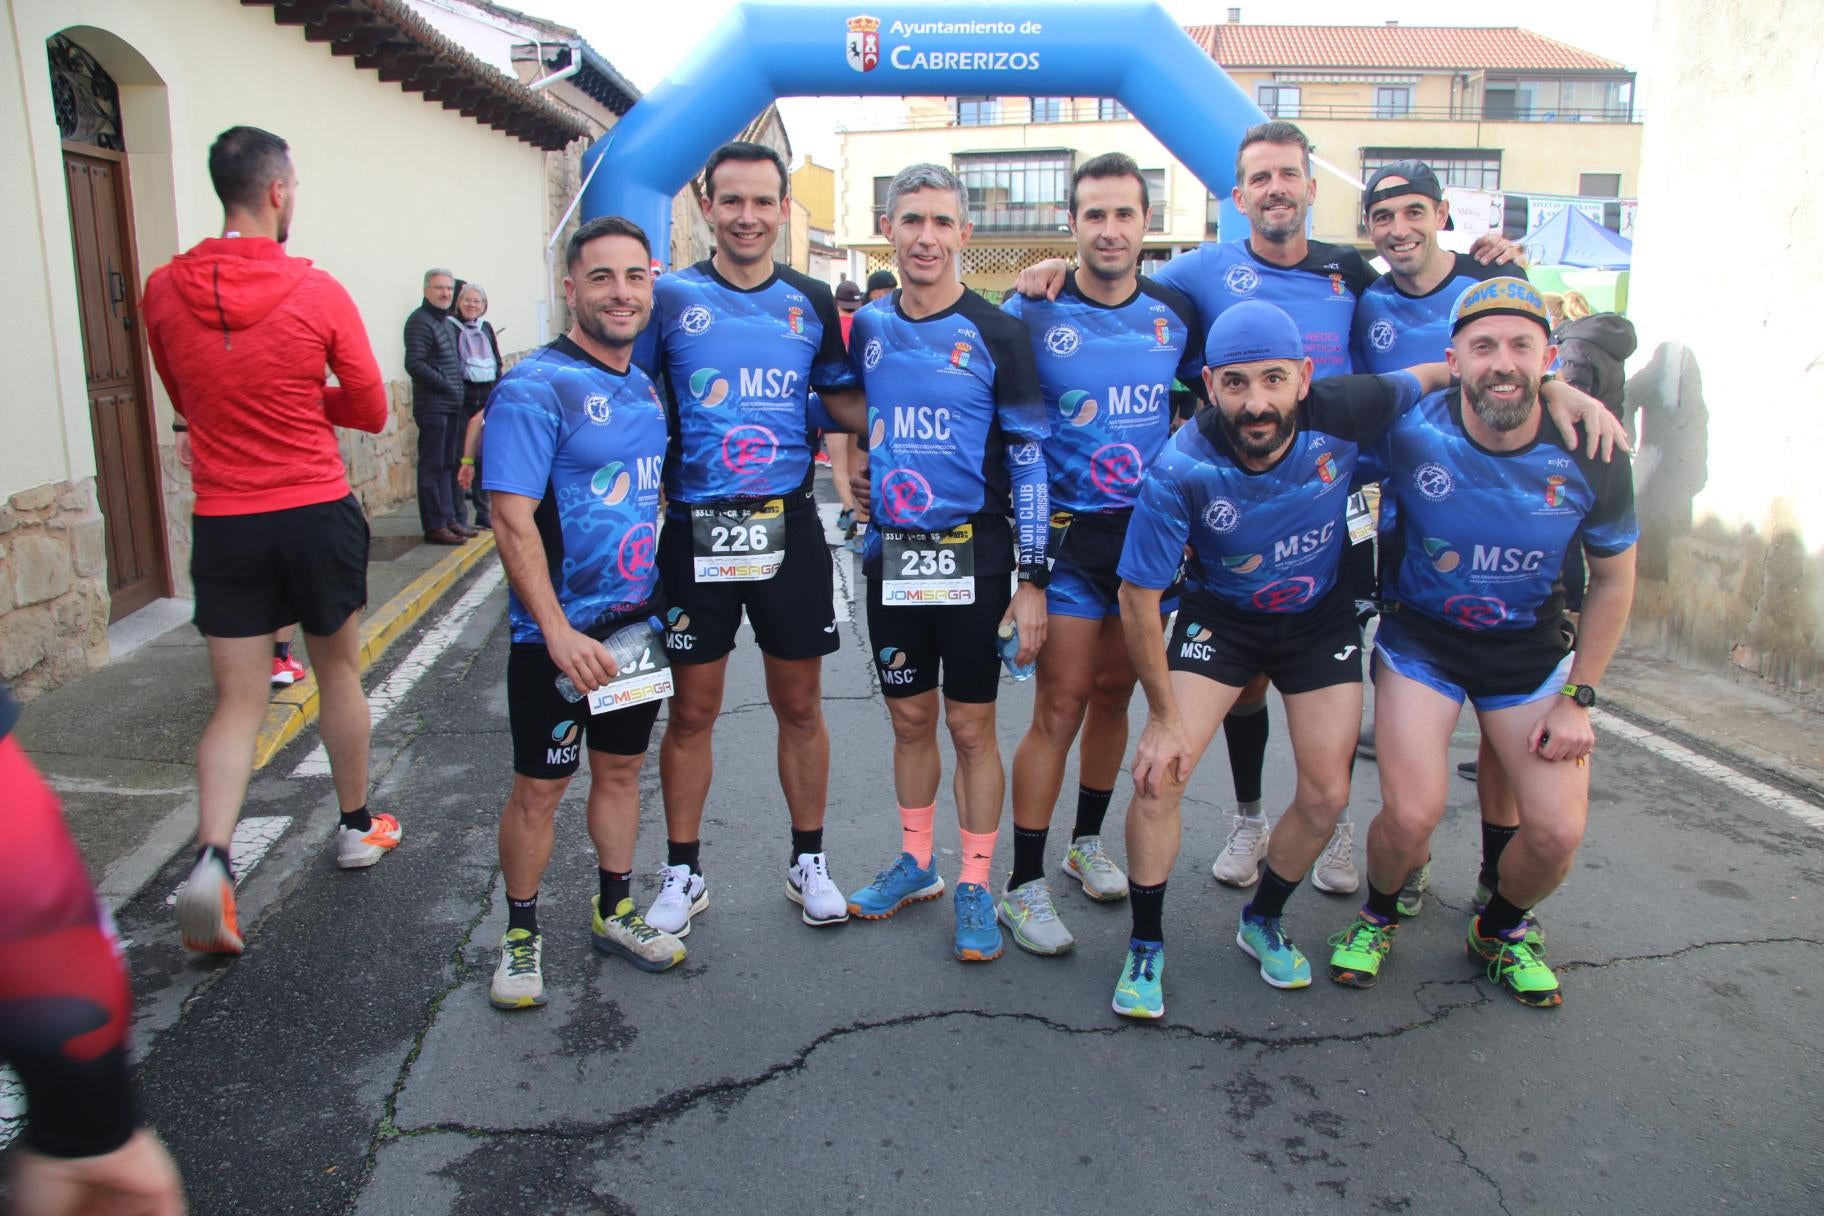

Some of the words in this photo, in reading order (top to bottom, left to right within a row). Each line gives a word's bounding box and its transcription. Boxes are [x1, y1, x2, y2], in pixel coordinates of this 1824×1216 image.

[890, 20, 1015, 38] Ayuntamiento
[1019, 19, 1042, 34] de
[890, 45, 1040, 70] CABRERIZOS
[740, 368, 798, 399] MSC
[1108, 383, 1165, 416] MSC
[894, 406, 951, 441] MSC
[1020, 484, 1034, 520] CLUB
[1036, 483, 1049, 522] MORISCOS
[711, 525, 768, 552] 226
[1036, 523, 1047, 534] DE
[1274, 520, 1336, 563] MSC
[698, 562, 781, 578] JOMISAGA
[901, 549, 956, 576] 236
[1472, 544, 1545, 573] MSC
[885, 589, 971, 601] JOMISAGA
[665, 633, 693, 650] MSC
[1180, 642, 1212, 662] MSC
[882, 668, 914, 685] MSC
[594, 681, 672, 709] JOMISAGA
[547, 744, 578, 764] MSC
